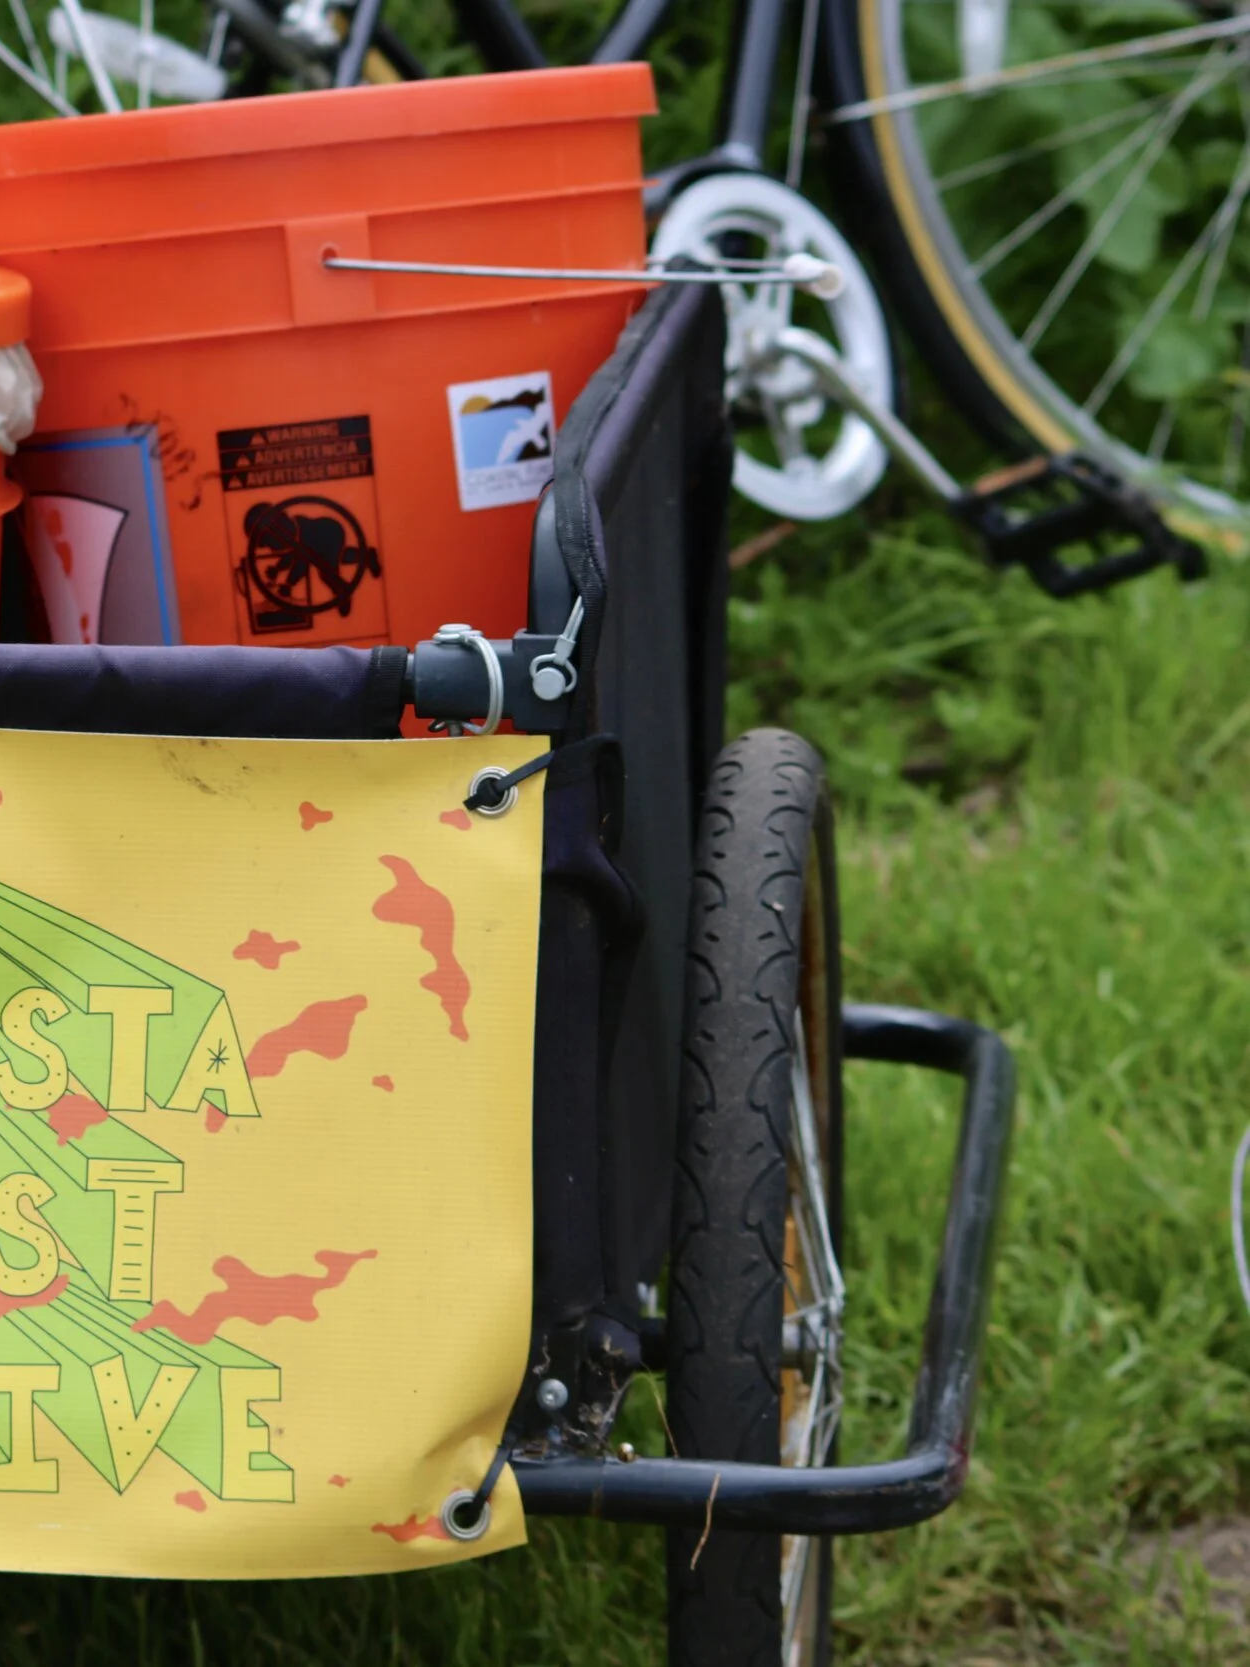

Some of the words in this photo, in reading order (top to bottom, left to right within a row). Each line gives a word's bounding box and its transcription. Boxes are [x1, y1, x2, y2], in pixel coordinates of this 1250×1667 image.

[267, 422, 339, 443] WARNING
[254, 440, 357, 464] ADVERTENCIA
[246, 460, 367, 486] AVERTISSEMENT
